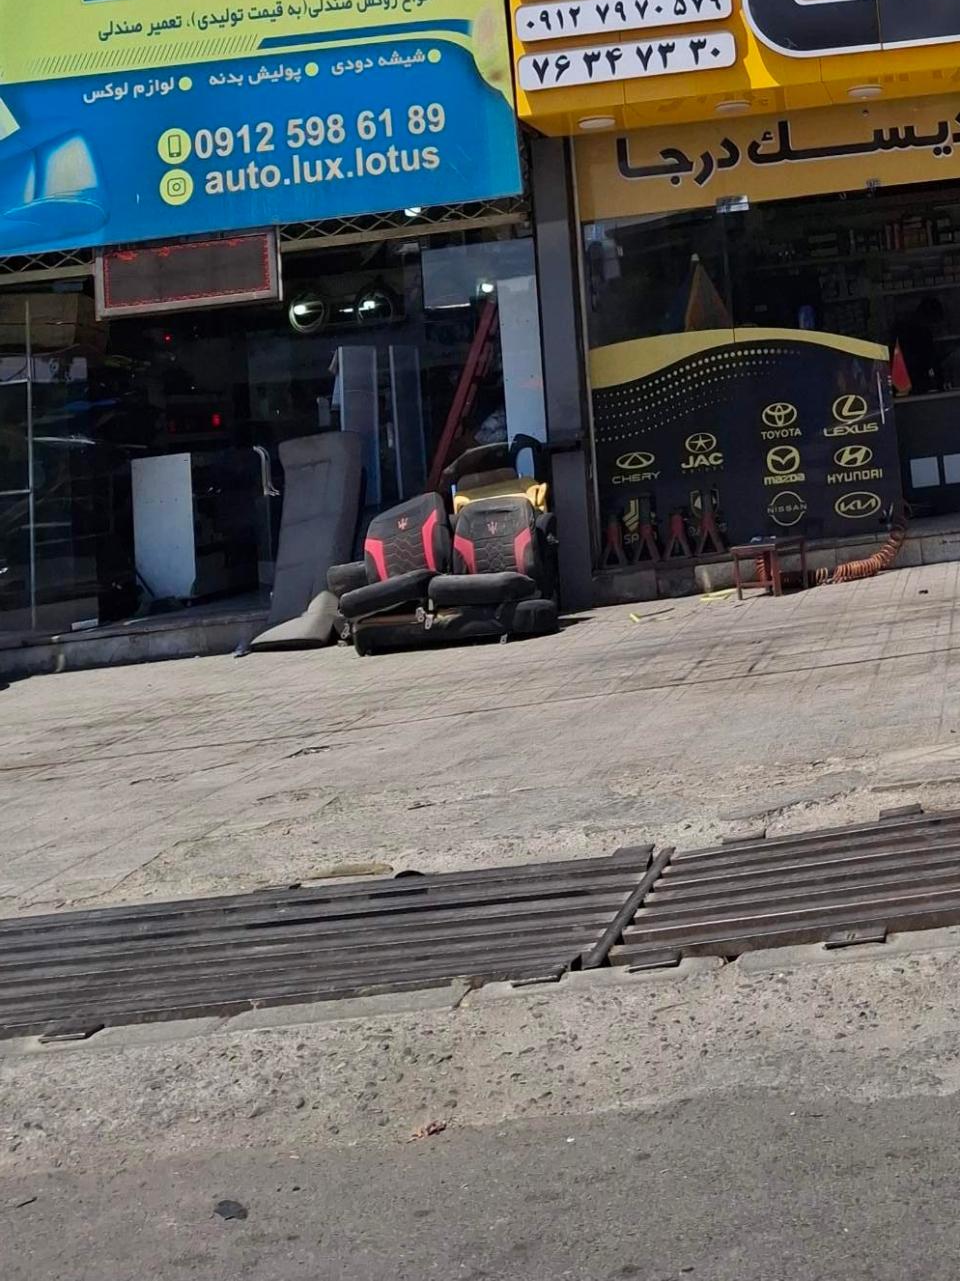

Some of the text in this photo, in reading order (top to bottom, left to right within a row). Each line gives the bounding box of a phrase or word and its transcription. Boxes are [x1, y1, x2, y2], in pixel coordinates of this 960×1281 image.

[247, 0, 284, 22] قیمت
[98, 21, 143, 42] صندلی
[147, 15, 182, 37] تعمیر
[331, 48, 426, 76] شیشه دودی
[208, 62, 302, 87] پولیش بدنه
[82, 76, 175, 104] لوازم لوکس
[194, 102, 446, 160] 0912 598 61 89
[204, 144, 441, 195] auto.lux.lotus
[615, 135, 740, 186] درجا
[761, 428, 802, 441] TOYOTA
[823, 422, 879, 437] LEXUS
[681, 452, 724, 470] JAC
[612, 471, 661, 485] CHERY
[827, 468, 883, 485] HYUNDAI
[767, 503, 808, 514] NISSAN
